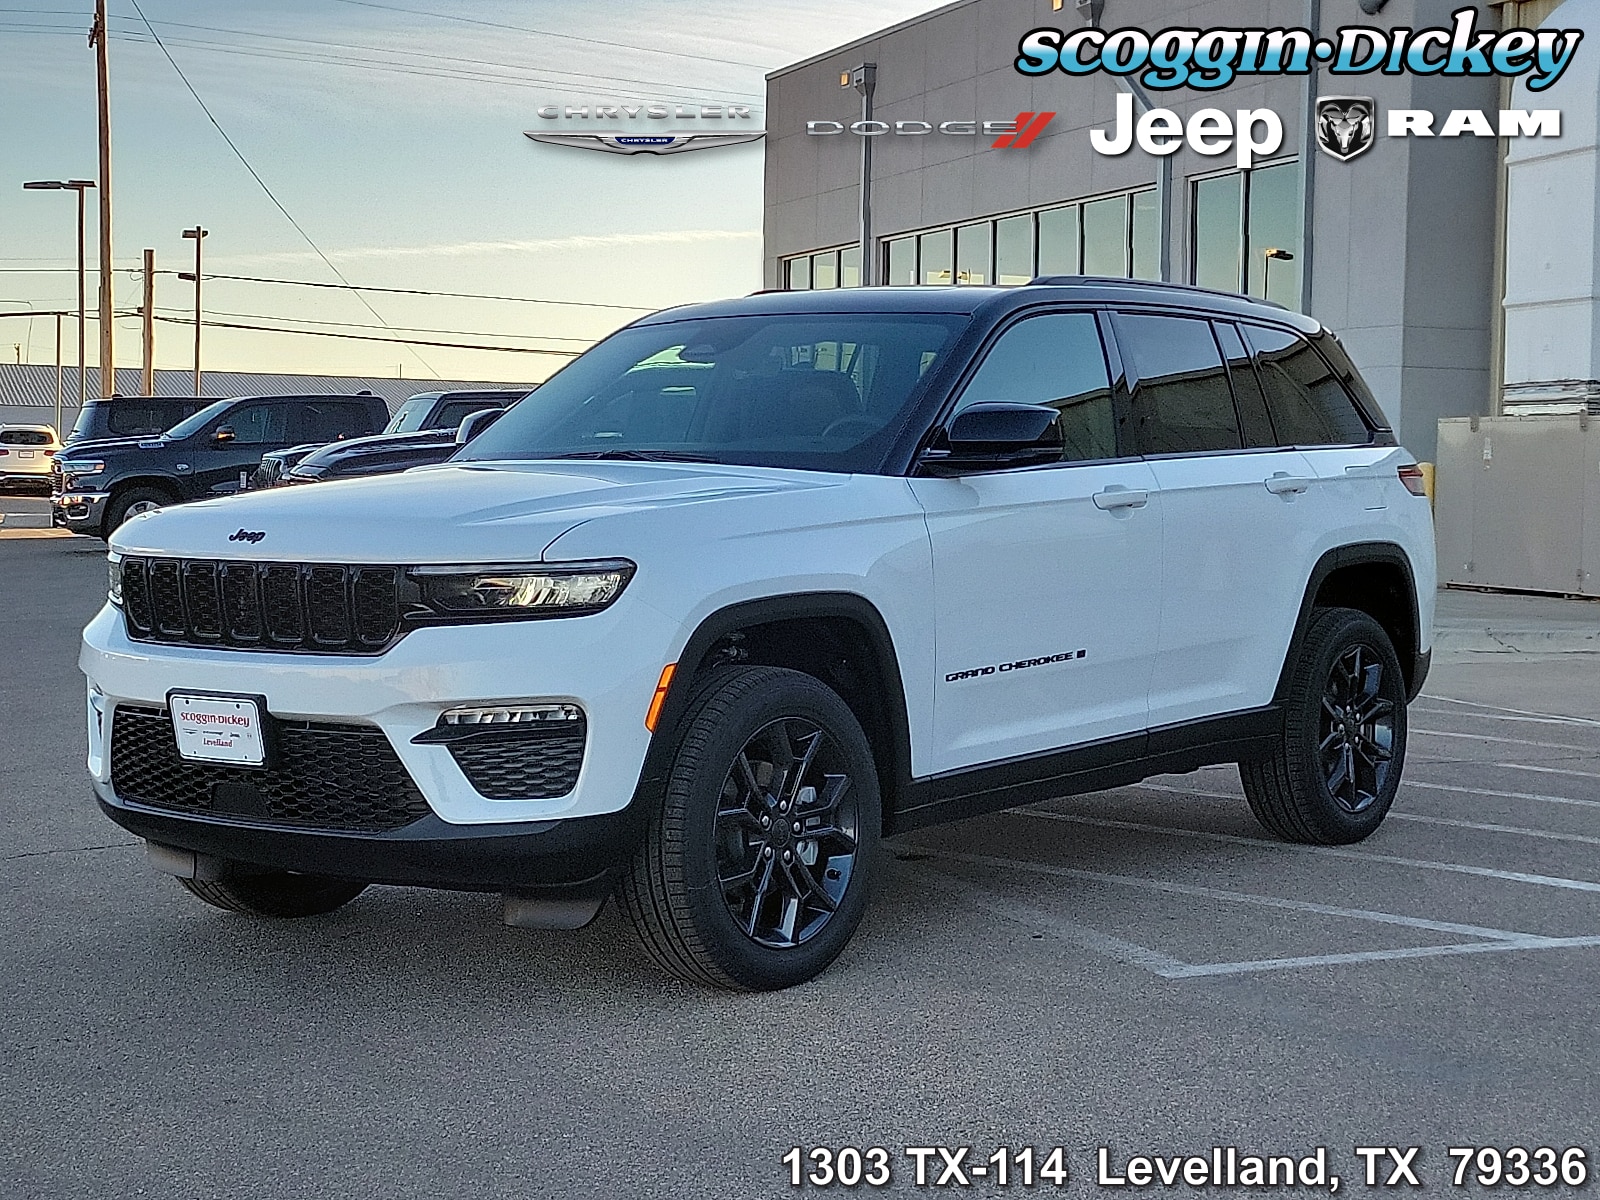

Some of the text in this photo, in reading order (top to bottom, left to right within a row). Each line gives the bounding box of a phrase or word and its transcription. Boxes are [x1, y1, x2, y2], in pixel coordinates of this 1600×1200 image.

[229, 529, 266, 544] Jeep
[945, 651, 1074, 682] GRAND CHEROKEE
[203, 738, 233, 748] Levelland
